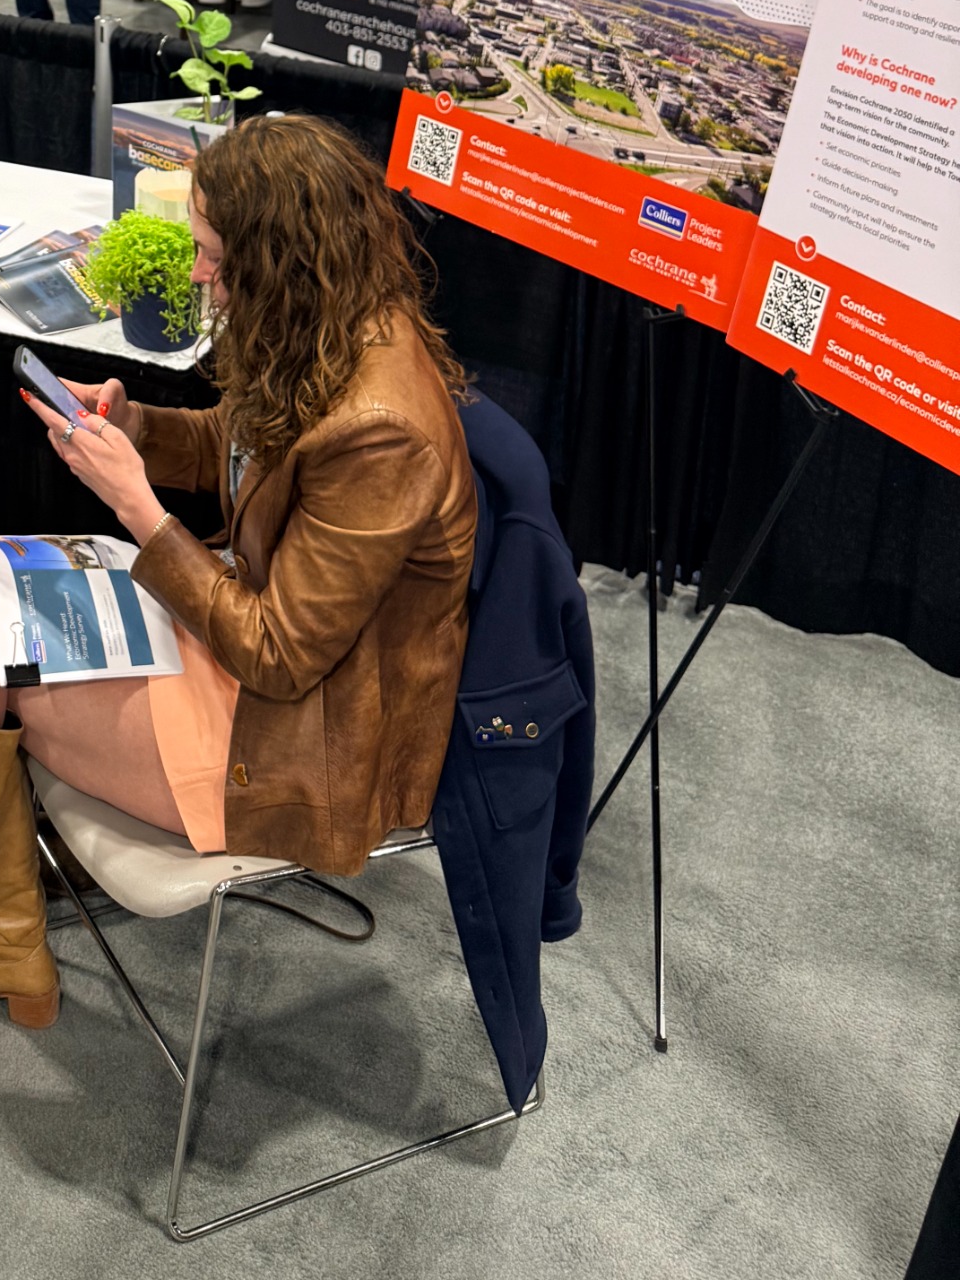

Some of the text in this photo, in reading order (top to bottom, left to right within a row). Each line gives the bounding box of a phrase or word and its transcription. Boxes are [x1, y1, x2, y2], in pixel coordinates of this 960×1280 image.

[836, 60, 957, 109] developing one now?
[841, 44, 935, 85] Why is Cochrane
[826, 96, 949, 148] long-term vision for the community.
[830, 85, 858, 101] Envision
[859, 95, 892, 113] Cochrane
[893, 107, 912, 120] 2050
[913, 115, 949, 133] identified
[129, 144, 190, 172] basecam
[142, 140, 177, 157] COCHRANE
[470, 135, 506, 156] Contact:
[820, 122, 946, 176] that vision into action. It will help the
[824, 111, 950, 166] The Economic Development Strategy
[462, 171, 571, 223] Scan the QR code or visit:
[646, 204, 680, 226] Colliers
[687, 230, 722, 252] Leaders
[690, 218, 722, 238] Project
[630, 248, 697, 282] cochrane
[840, 295, 886, 326] Contact:
[826, 339, 853, 361] Scan
[854, 354, 872, 371] the
[873, 364, 892, 382] QR
[893, 377, 921, 397] code
[922, 393, 936, 404] or
[60, 613, 68, 632] Heard
[63, 591, 81, 660] Economic Development
[76, 614, 89, 660] Strategy Survey
